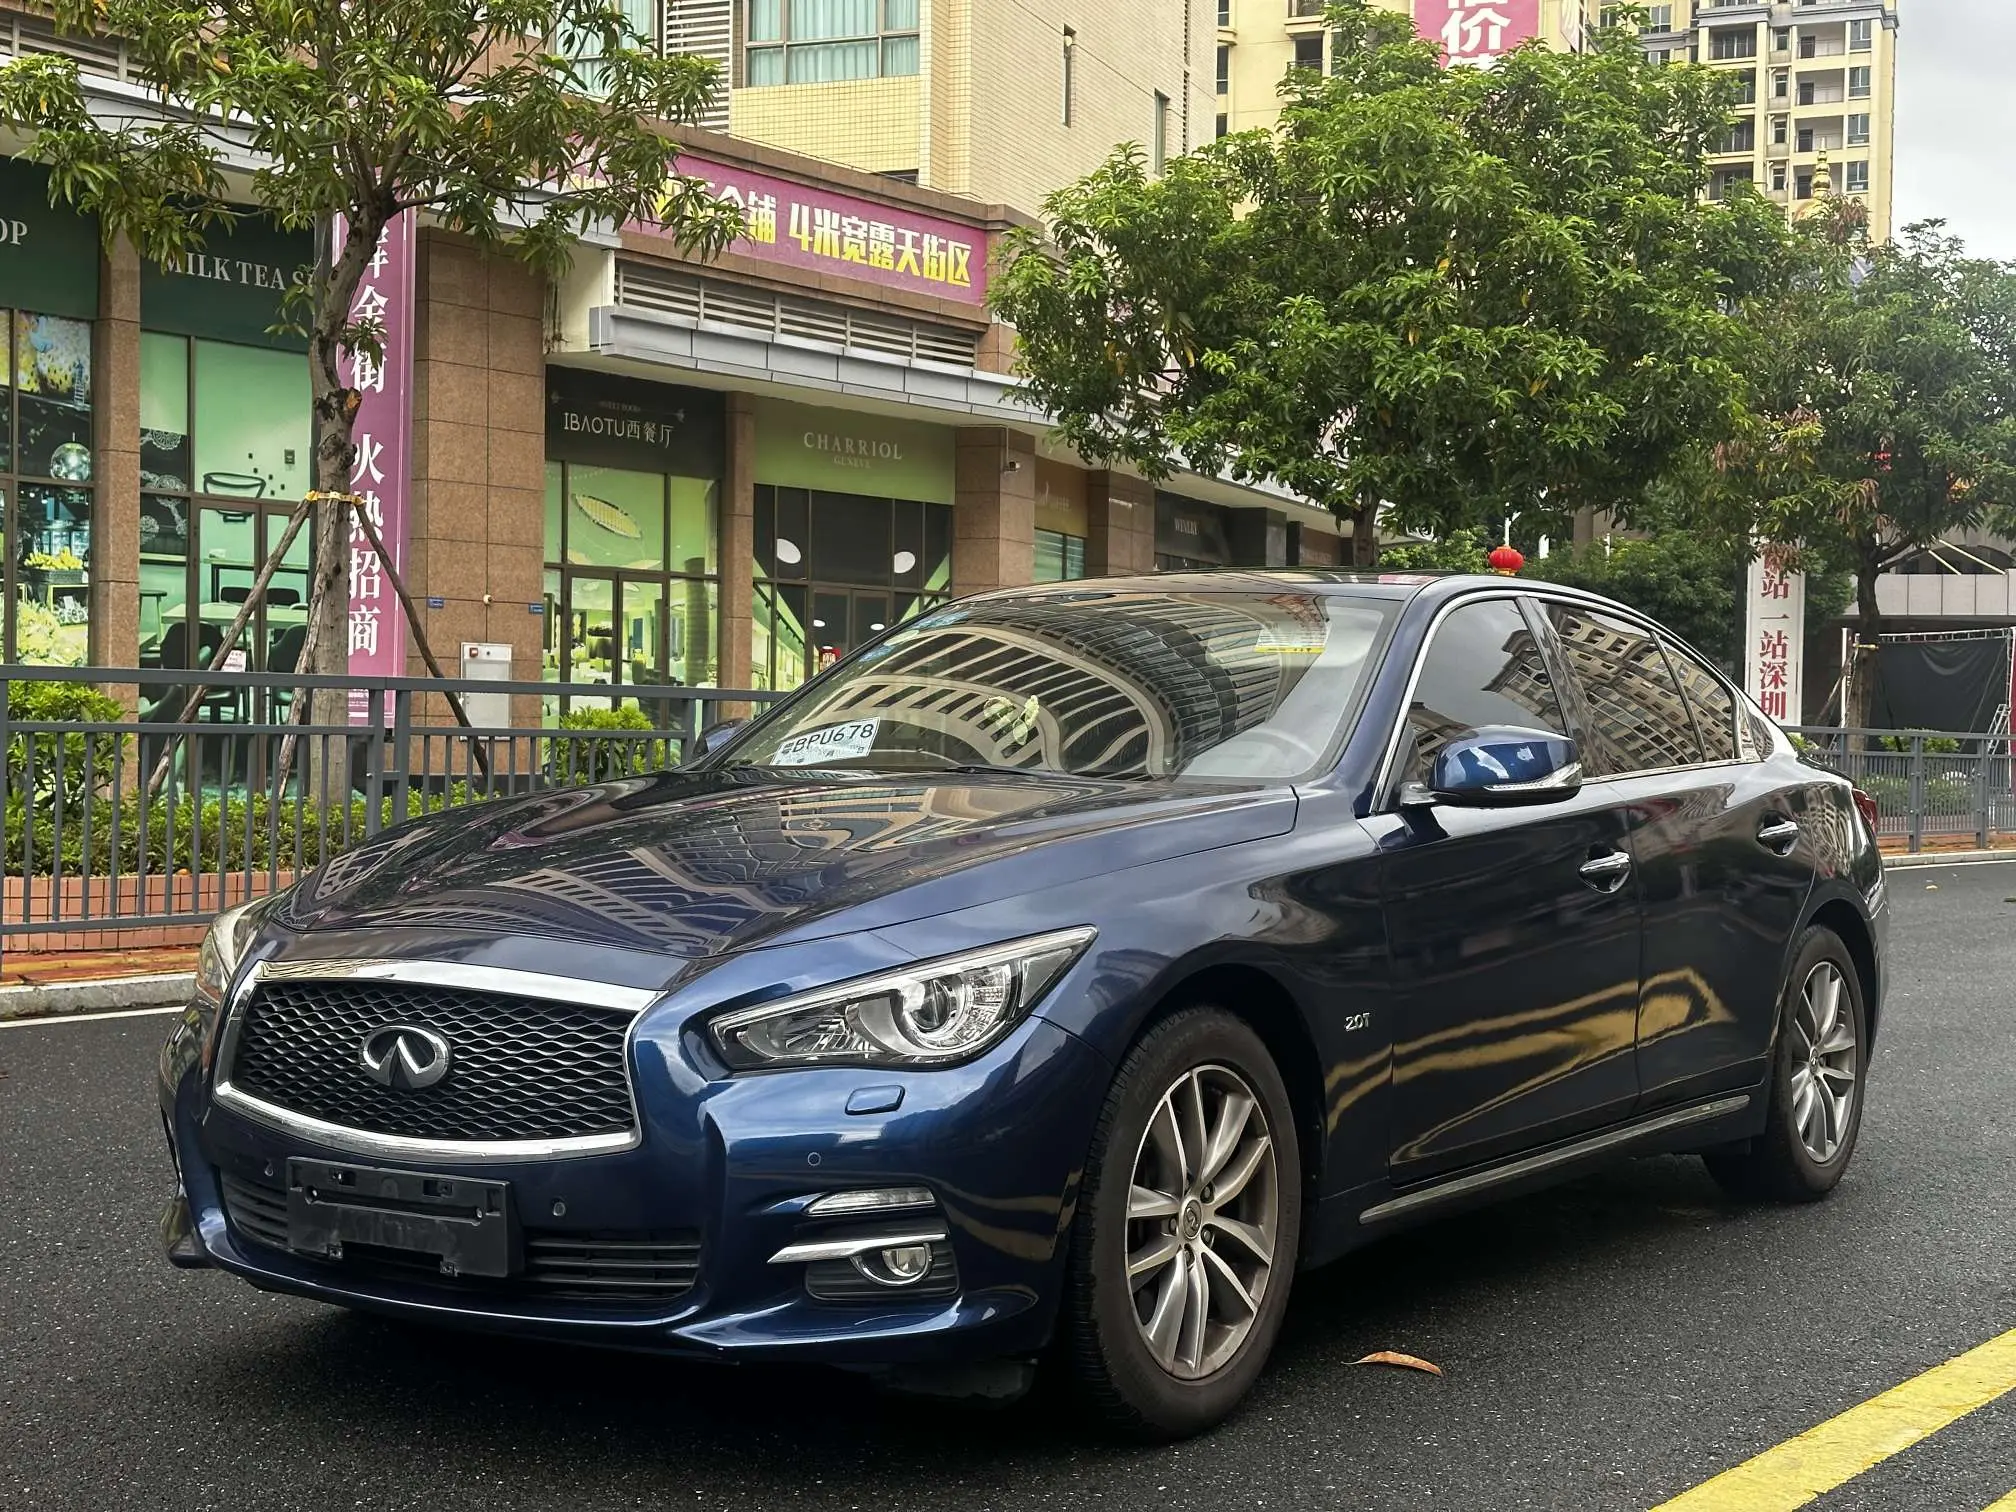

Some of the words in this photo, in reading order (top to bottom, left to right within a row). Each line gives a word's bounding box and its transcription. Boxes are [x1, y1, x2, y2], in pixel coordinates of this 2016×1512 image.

[788, 202, 972, 288] 4米宽露天街区
[236, 261, 286, 290] TEA
[803, 431, 902, 460] CHARRIOL
